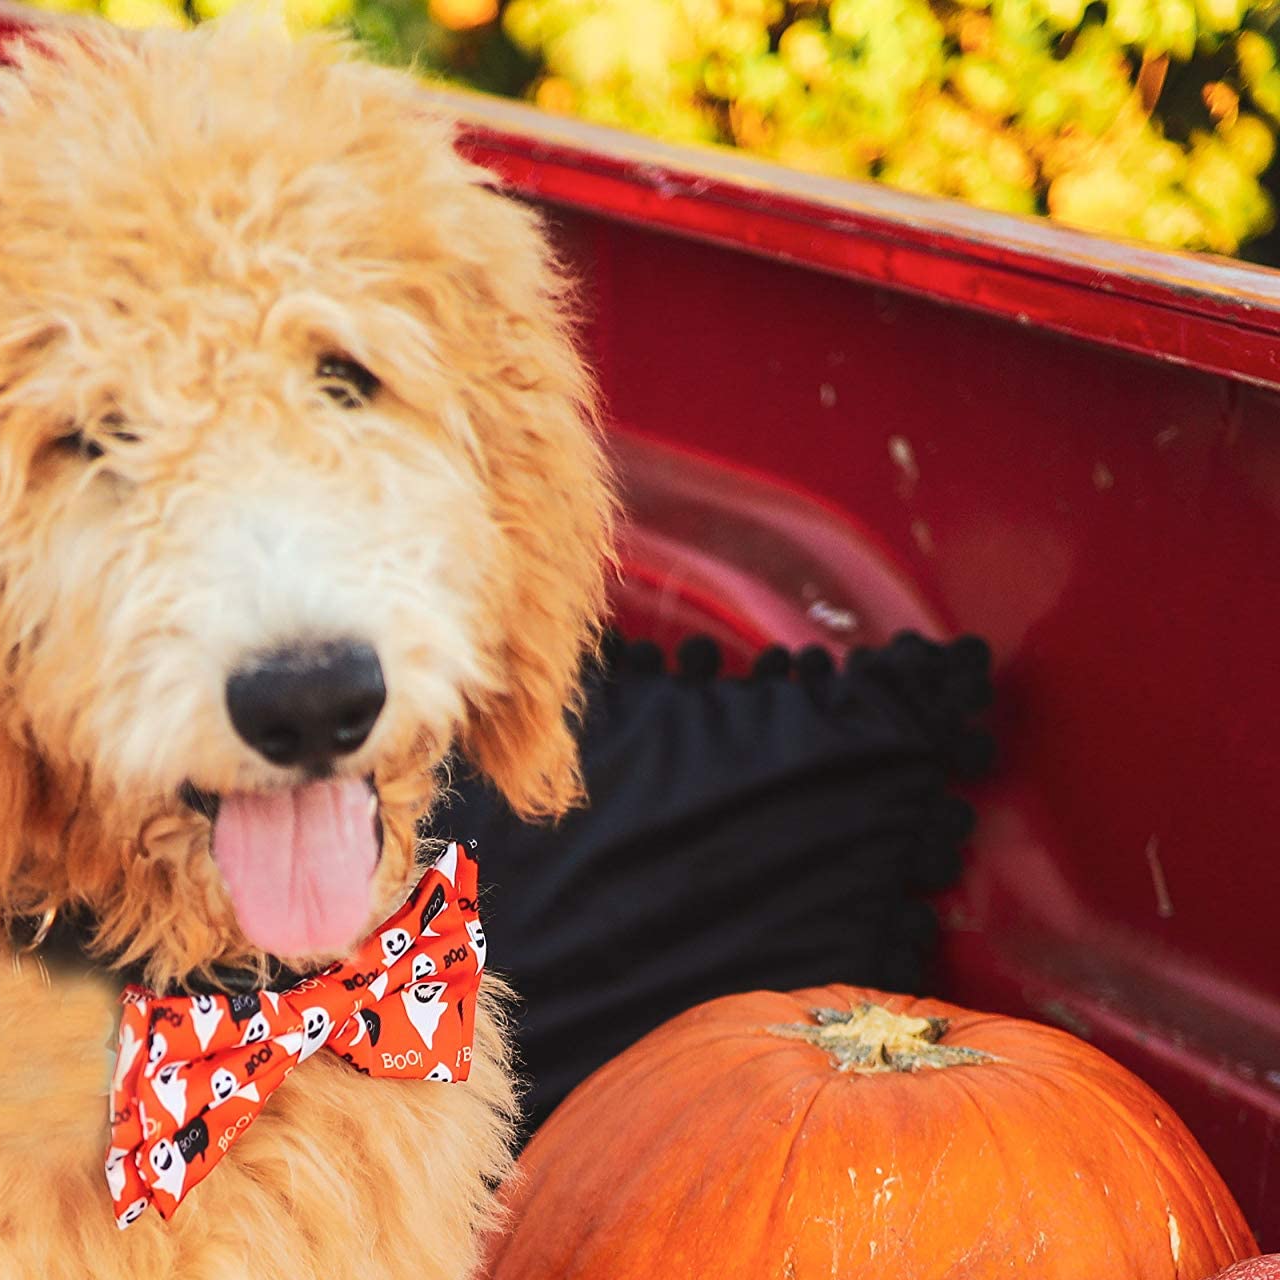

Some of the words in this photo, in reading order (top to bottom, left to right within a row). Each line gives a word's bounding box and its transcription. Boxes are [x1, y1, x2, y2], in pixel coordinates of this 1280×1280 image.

[443, 944, 467, 969] BOO!
[245, 1043, 273, 1077] BOO!
[381, 1049, 424, 1070] BOO!
[217, 1111, 254, 1152] BOO!
